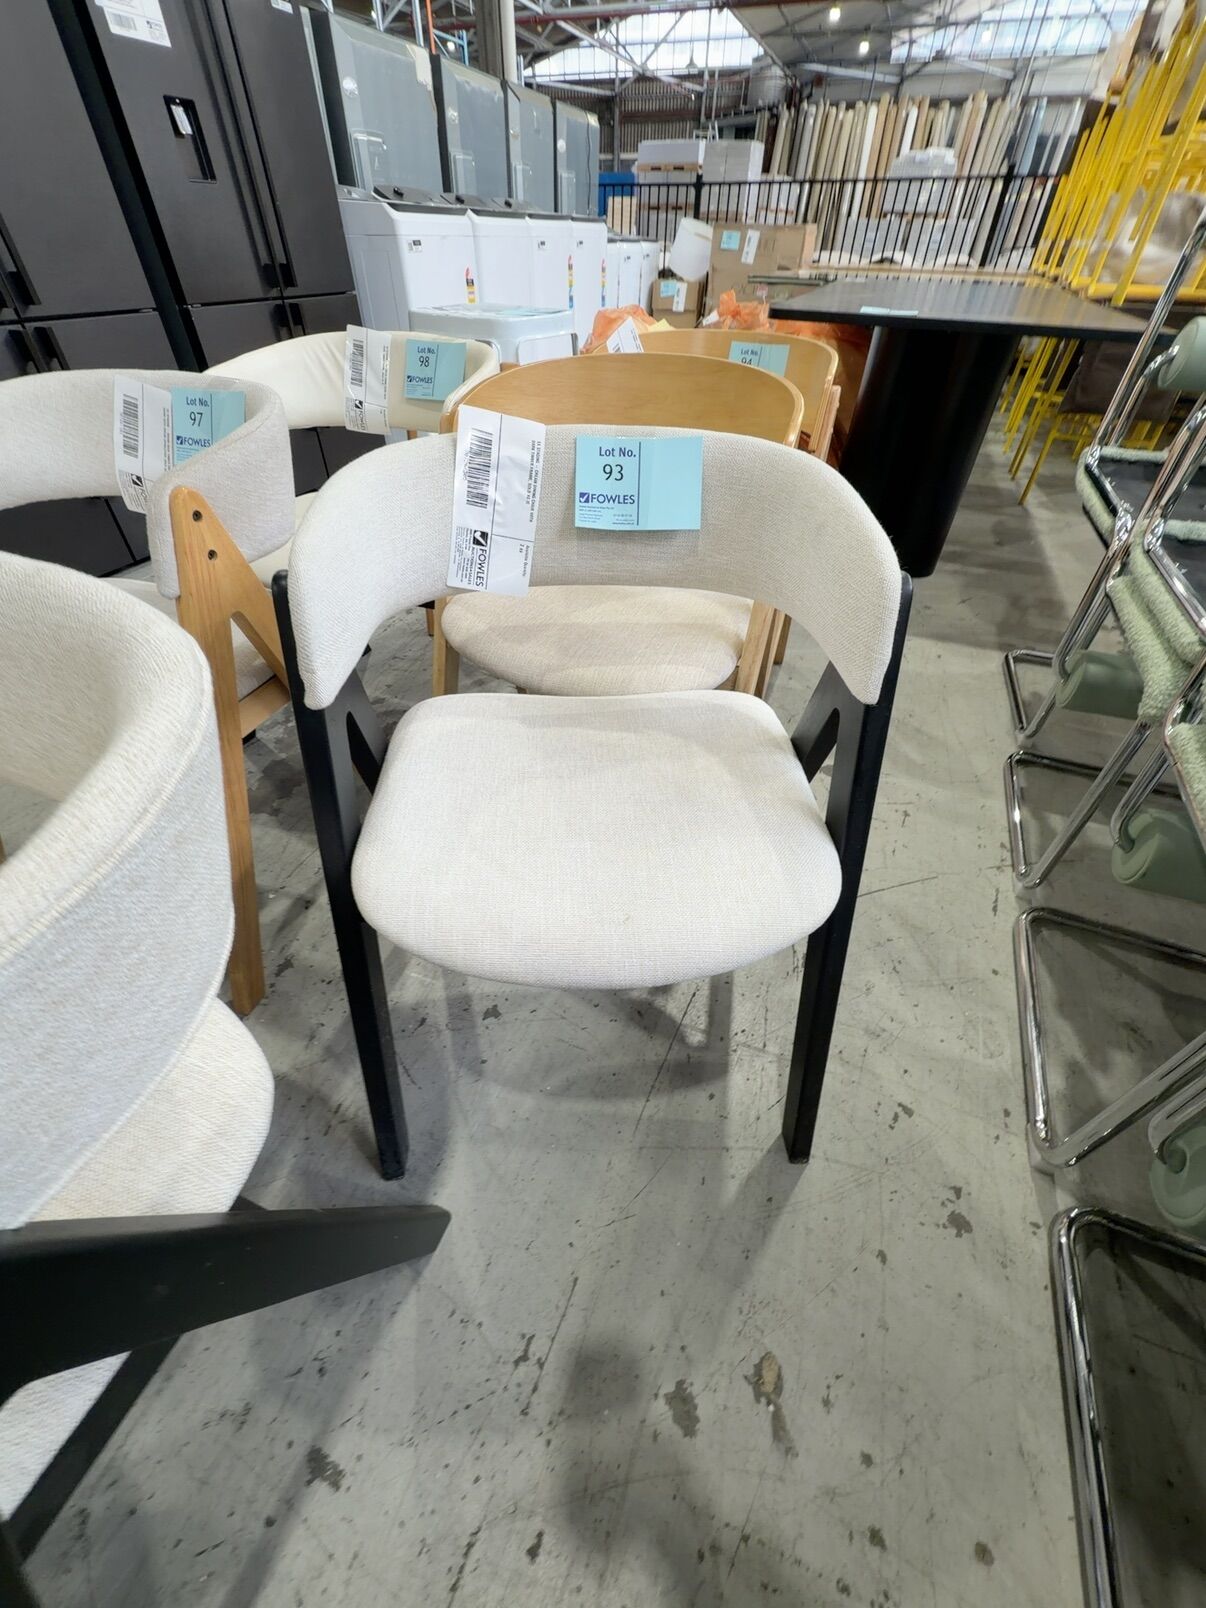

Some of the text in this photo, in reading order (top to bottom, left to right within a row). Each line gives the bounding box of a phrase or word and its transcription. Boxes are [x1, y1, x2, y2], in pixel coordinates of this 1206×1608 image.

[417, 346, 427, 354] Lot
[418, 355, 430, 368] 98
[412, 375, 433, 384] FOWLES
[186, 396, 210, 408] Lot No.
[189, 411, 203, 427] 97
[183, 437, 211, 448] FOWLES
[599, 446, 637, 458] Lot No.
[602, 464, 624, 481] 93
[590, 493, 636, 505] FOWLES
[475, 548, 487, 587] FOWLES
